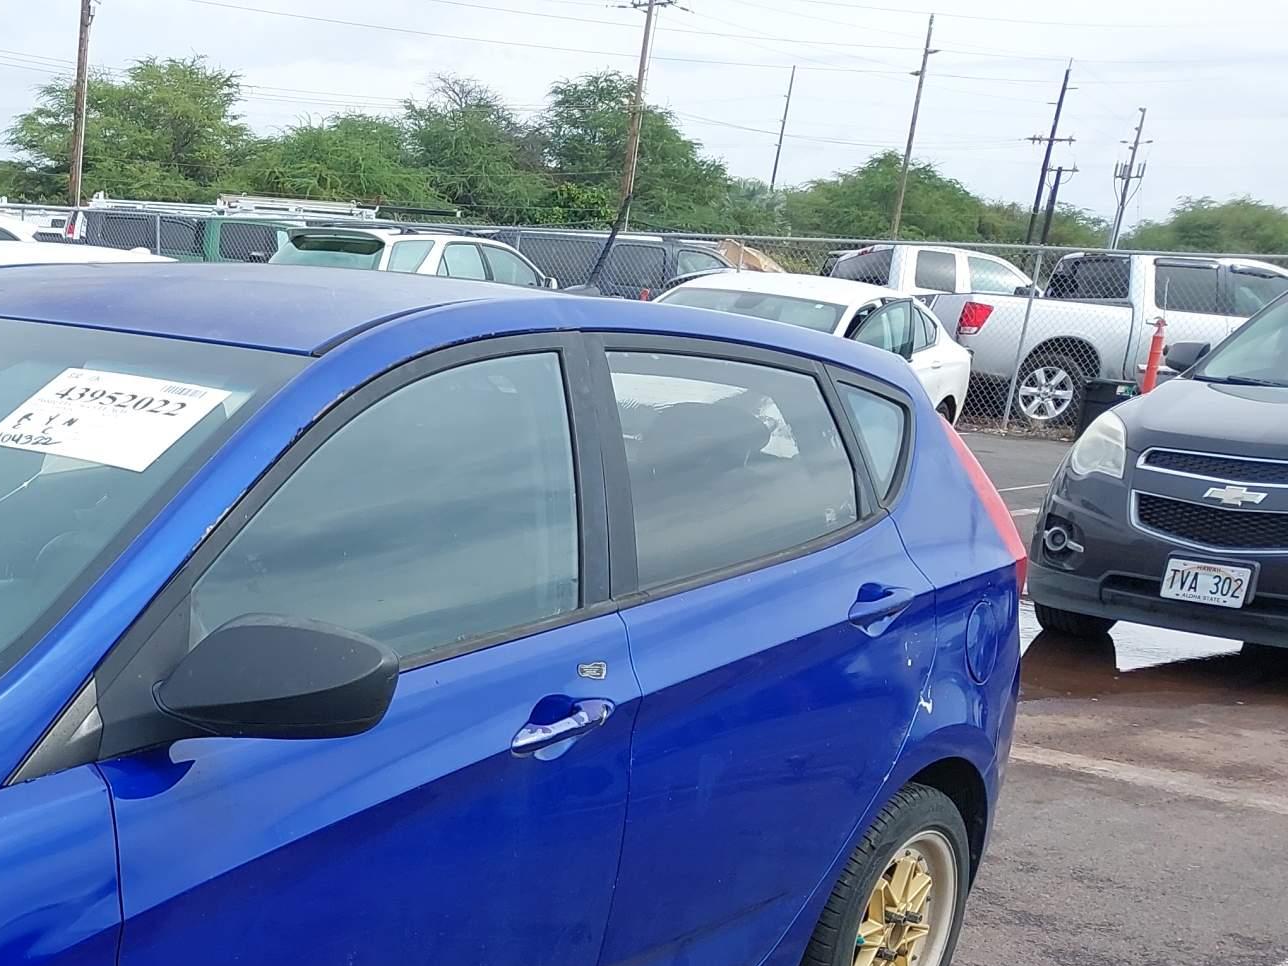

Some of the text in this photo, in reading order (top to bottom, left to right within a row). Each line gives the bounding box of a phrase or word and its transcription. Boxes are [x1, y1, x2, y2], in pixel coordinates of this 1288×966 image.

[55, 385, 187, 417] 43952022
[1169, 569, 1244, 599] TVA 302
[1181, 592, 1201, 600] ALOHA
